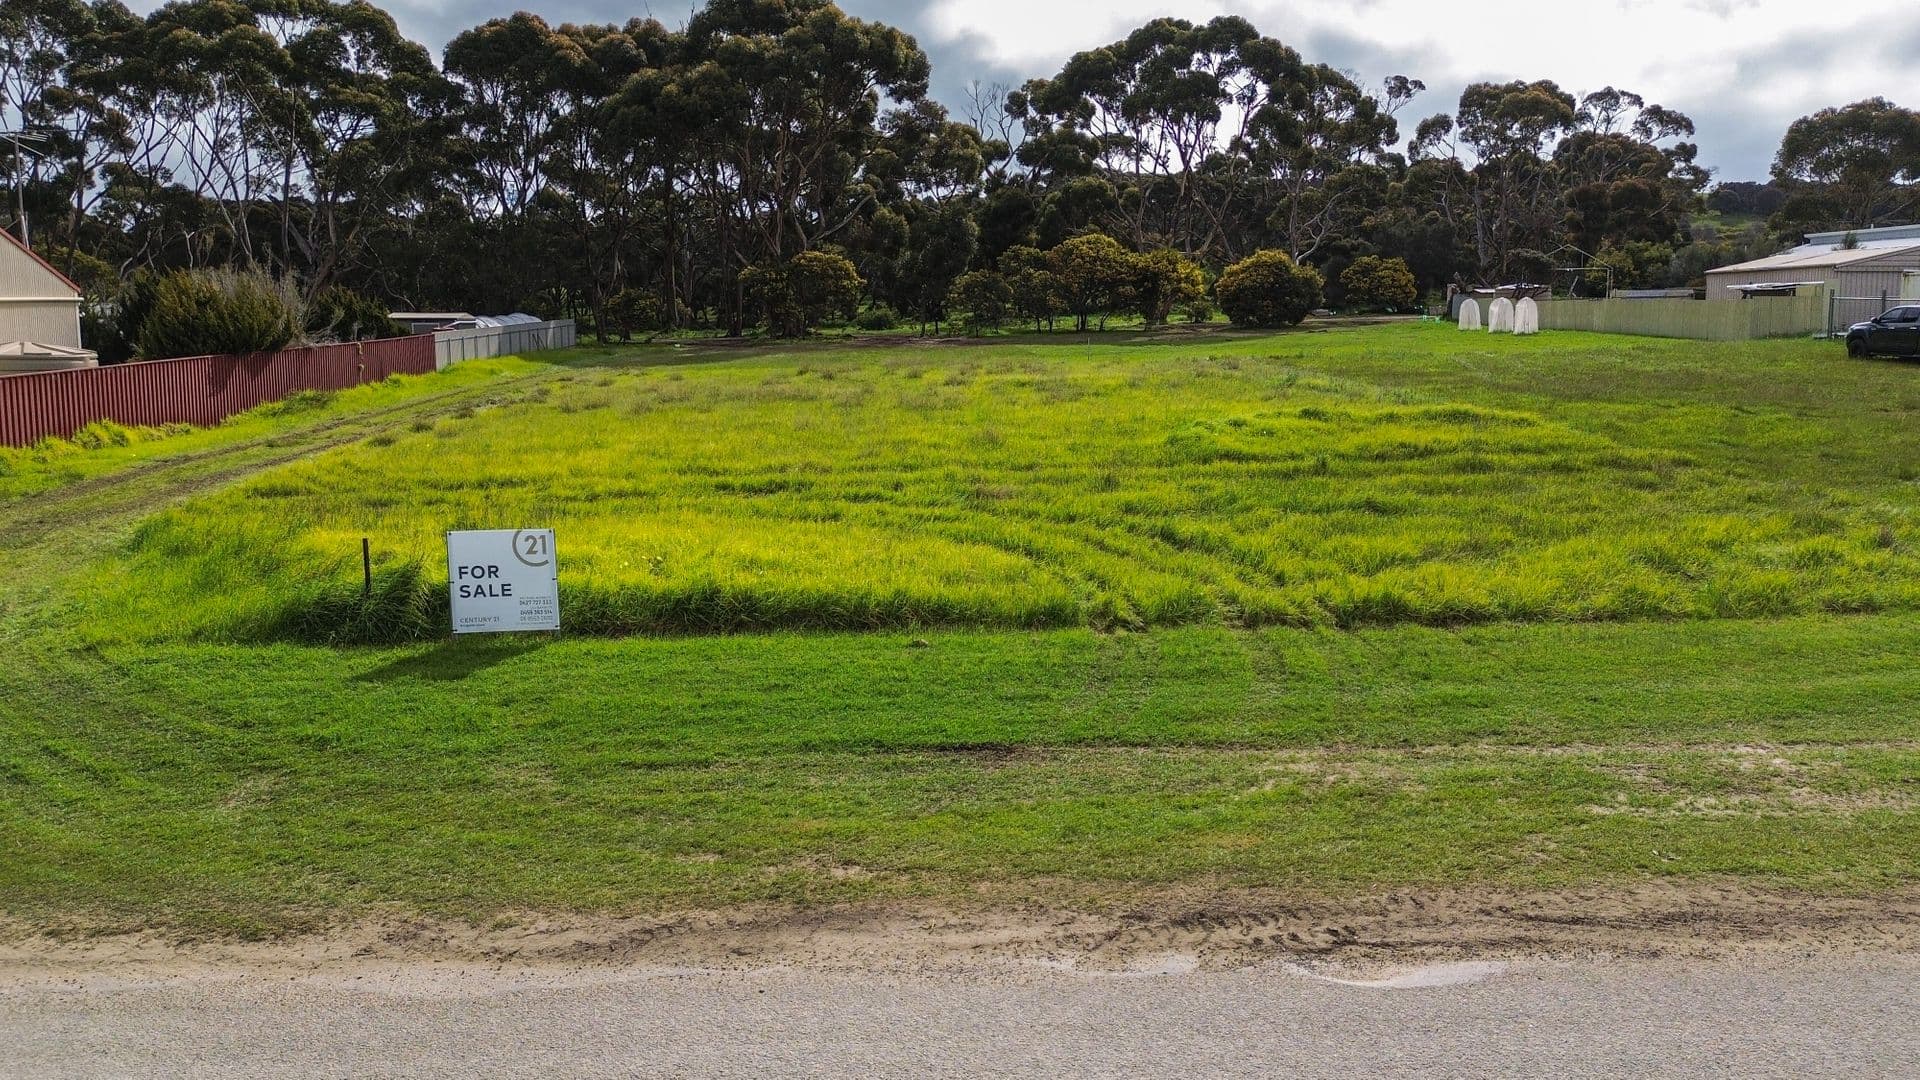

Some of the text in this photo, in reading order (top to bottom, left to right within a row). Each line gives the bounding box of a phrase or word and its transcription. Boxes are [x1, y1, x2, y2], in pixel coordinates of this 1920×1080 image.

[524, 535, 547, 555] 21
[458, 565, 499, 579] FOR
[459, 583, 512, 598] SALE
[459, 616, 492, 624] CENTURY
